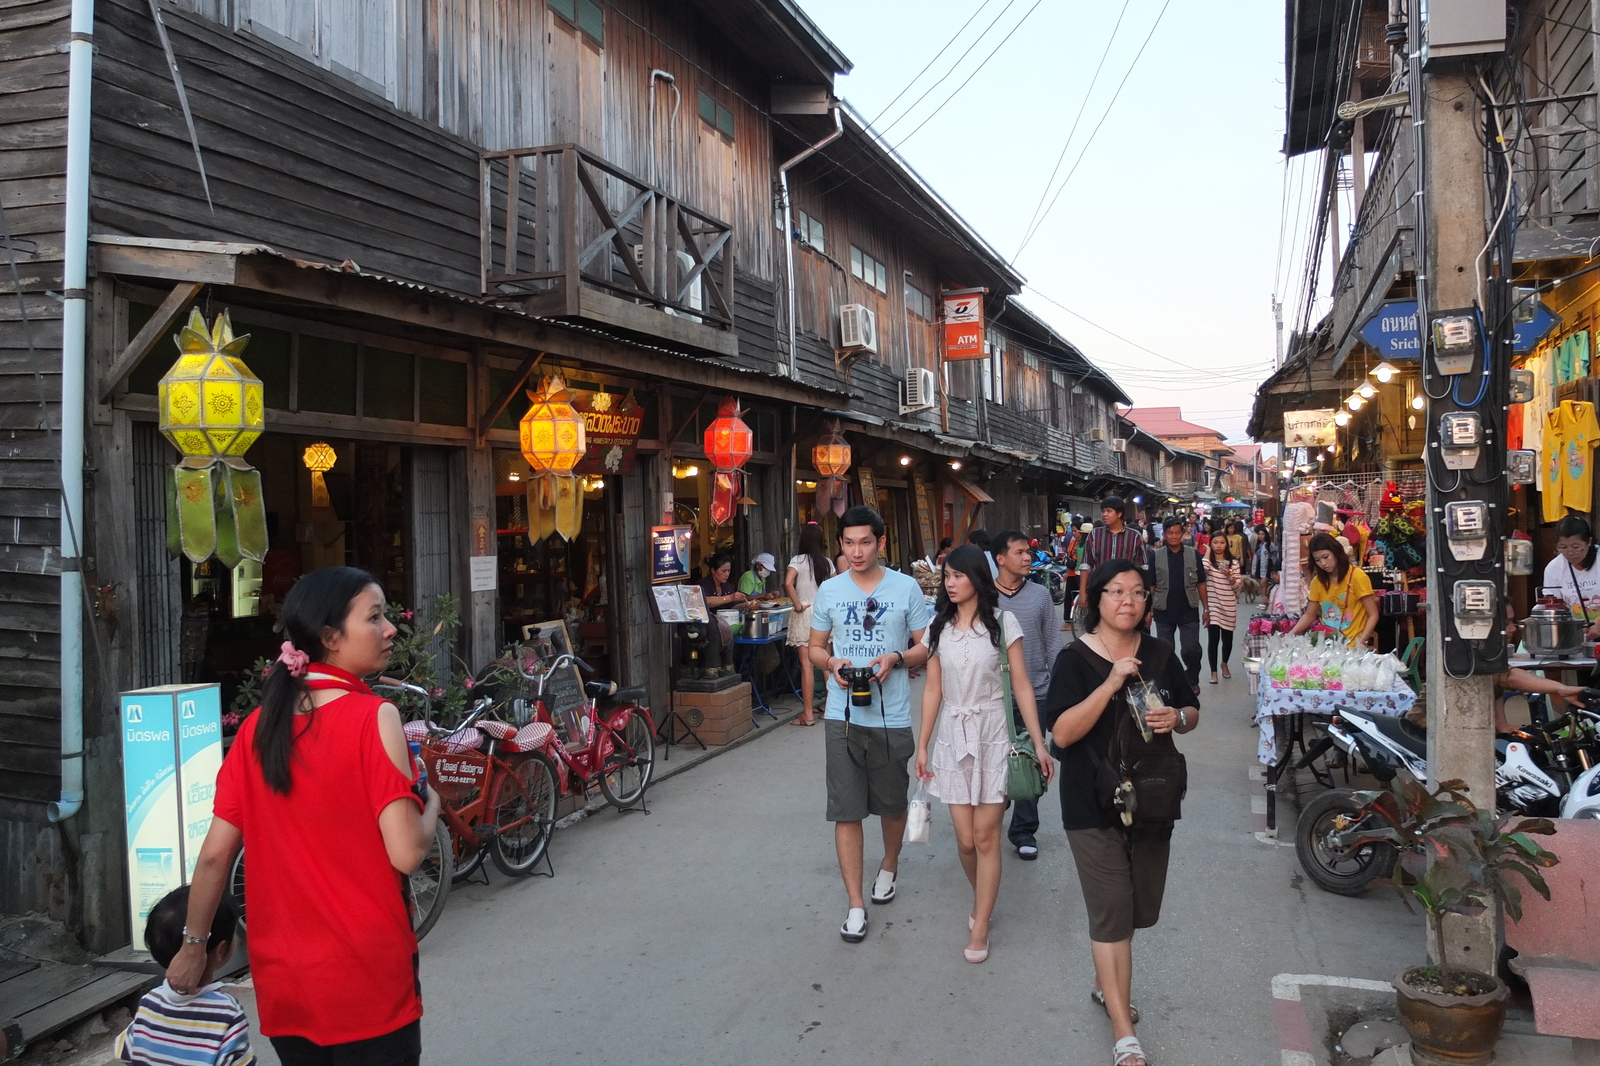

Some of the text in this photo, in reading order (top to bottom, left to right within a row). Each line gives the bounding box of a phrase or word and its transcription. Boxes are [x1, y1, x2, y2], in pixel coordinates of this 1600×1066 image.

[957, 334, 978, 345] ATM
[846, 629, 885, 642] 1995
[1516, 764, 1554, 788] Kawasaki
